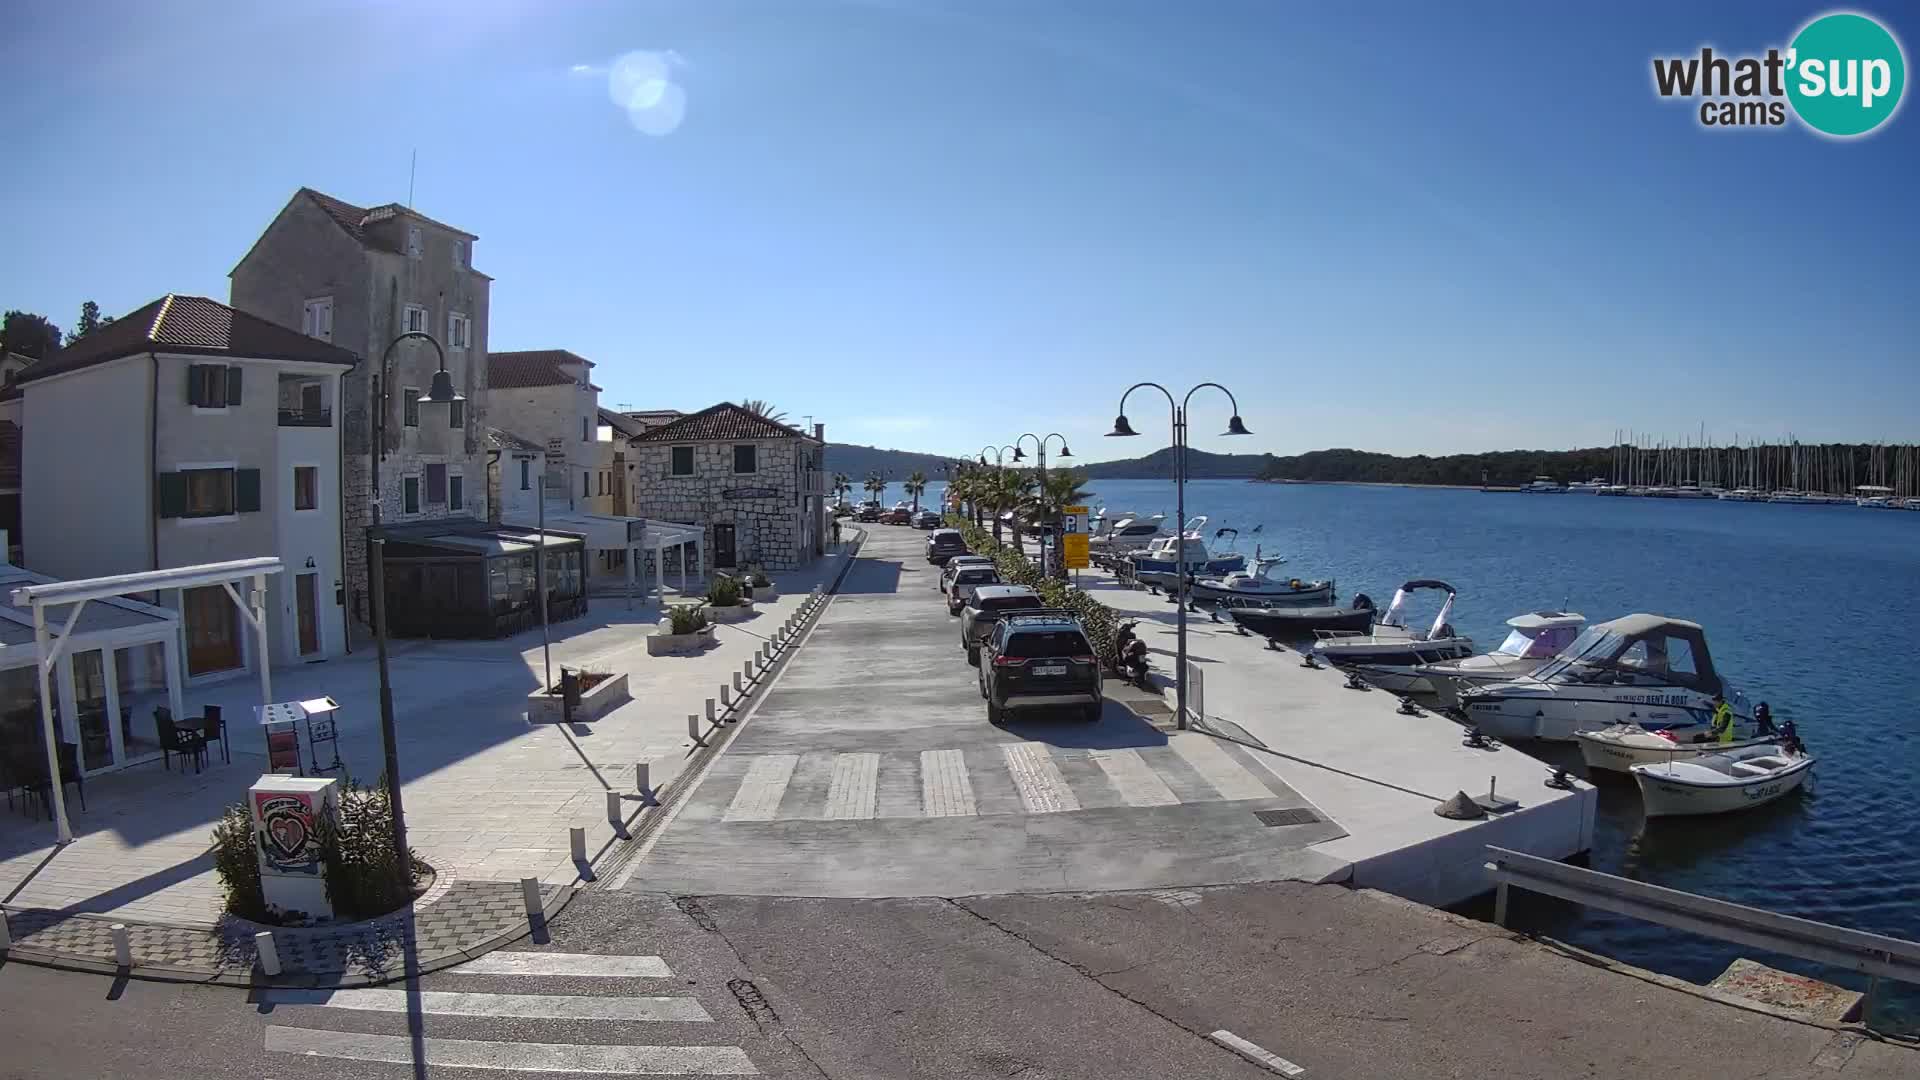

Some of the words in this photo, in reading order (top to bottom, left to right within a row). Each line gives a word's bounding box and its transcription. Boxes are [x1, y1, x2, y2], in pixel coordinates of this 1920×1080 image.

[1065, 515, 1076, 532] P
[1646, 695, 1664, 704] RENT
[1665, 695, 1670, 704] A
[1671, 695, 1688, 705] BOAT
